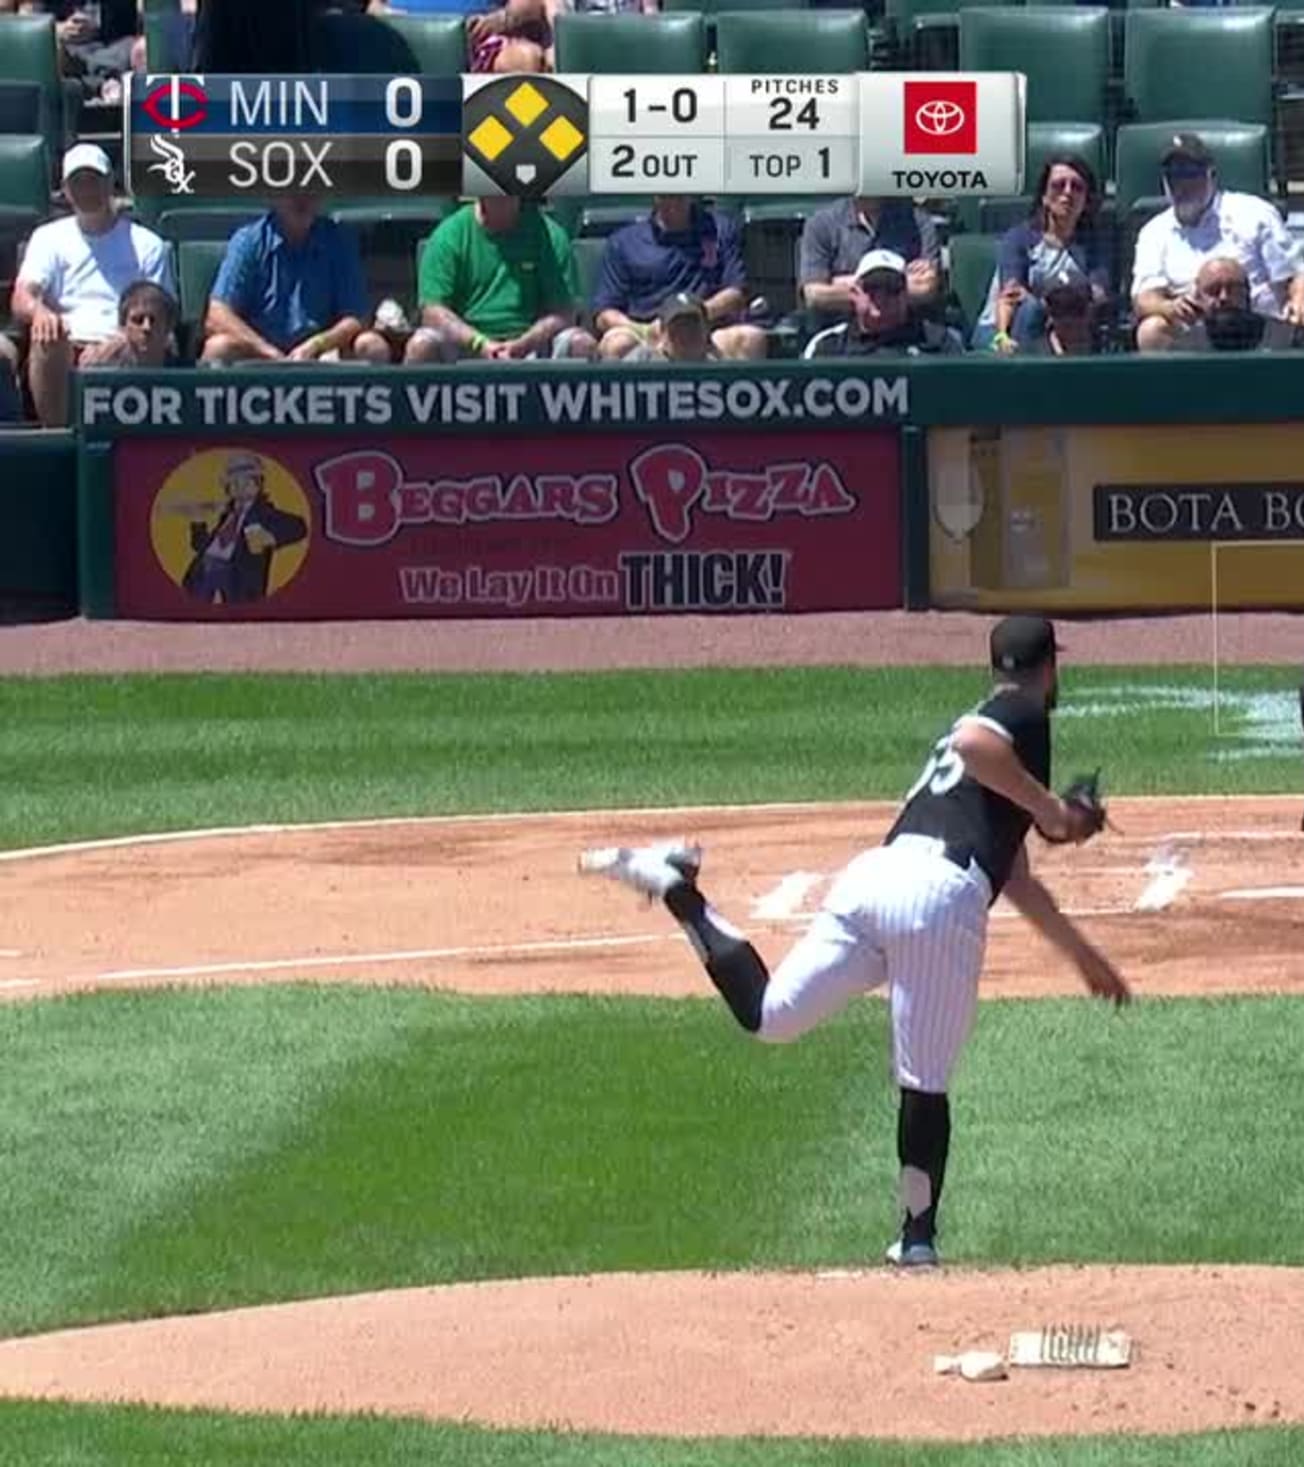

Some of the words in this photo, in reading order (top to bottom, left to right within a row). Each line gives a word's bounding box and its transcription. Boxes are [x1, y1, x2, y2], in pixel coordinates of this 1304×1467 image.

[83, 386, 183, 425] FOR
[195, 385, 392, 425] TICKETS
[406, 382, 526, 423] VISIT
[540, 376, 909, 422] WHITESOX.COM
[1108, 492, 1244, 534] BOTA
[399, 565, 463, 603] We
[469, 564, 534, 607] Lay
[536, 566, 566, 604] It
[568, 566, 619, 601] On
[618, 548, 790, 610] THICK!
